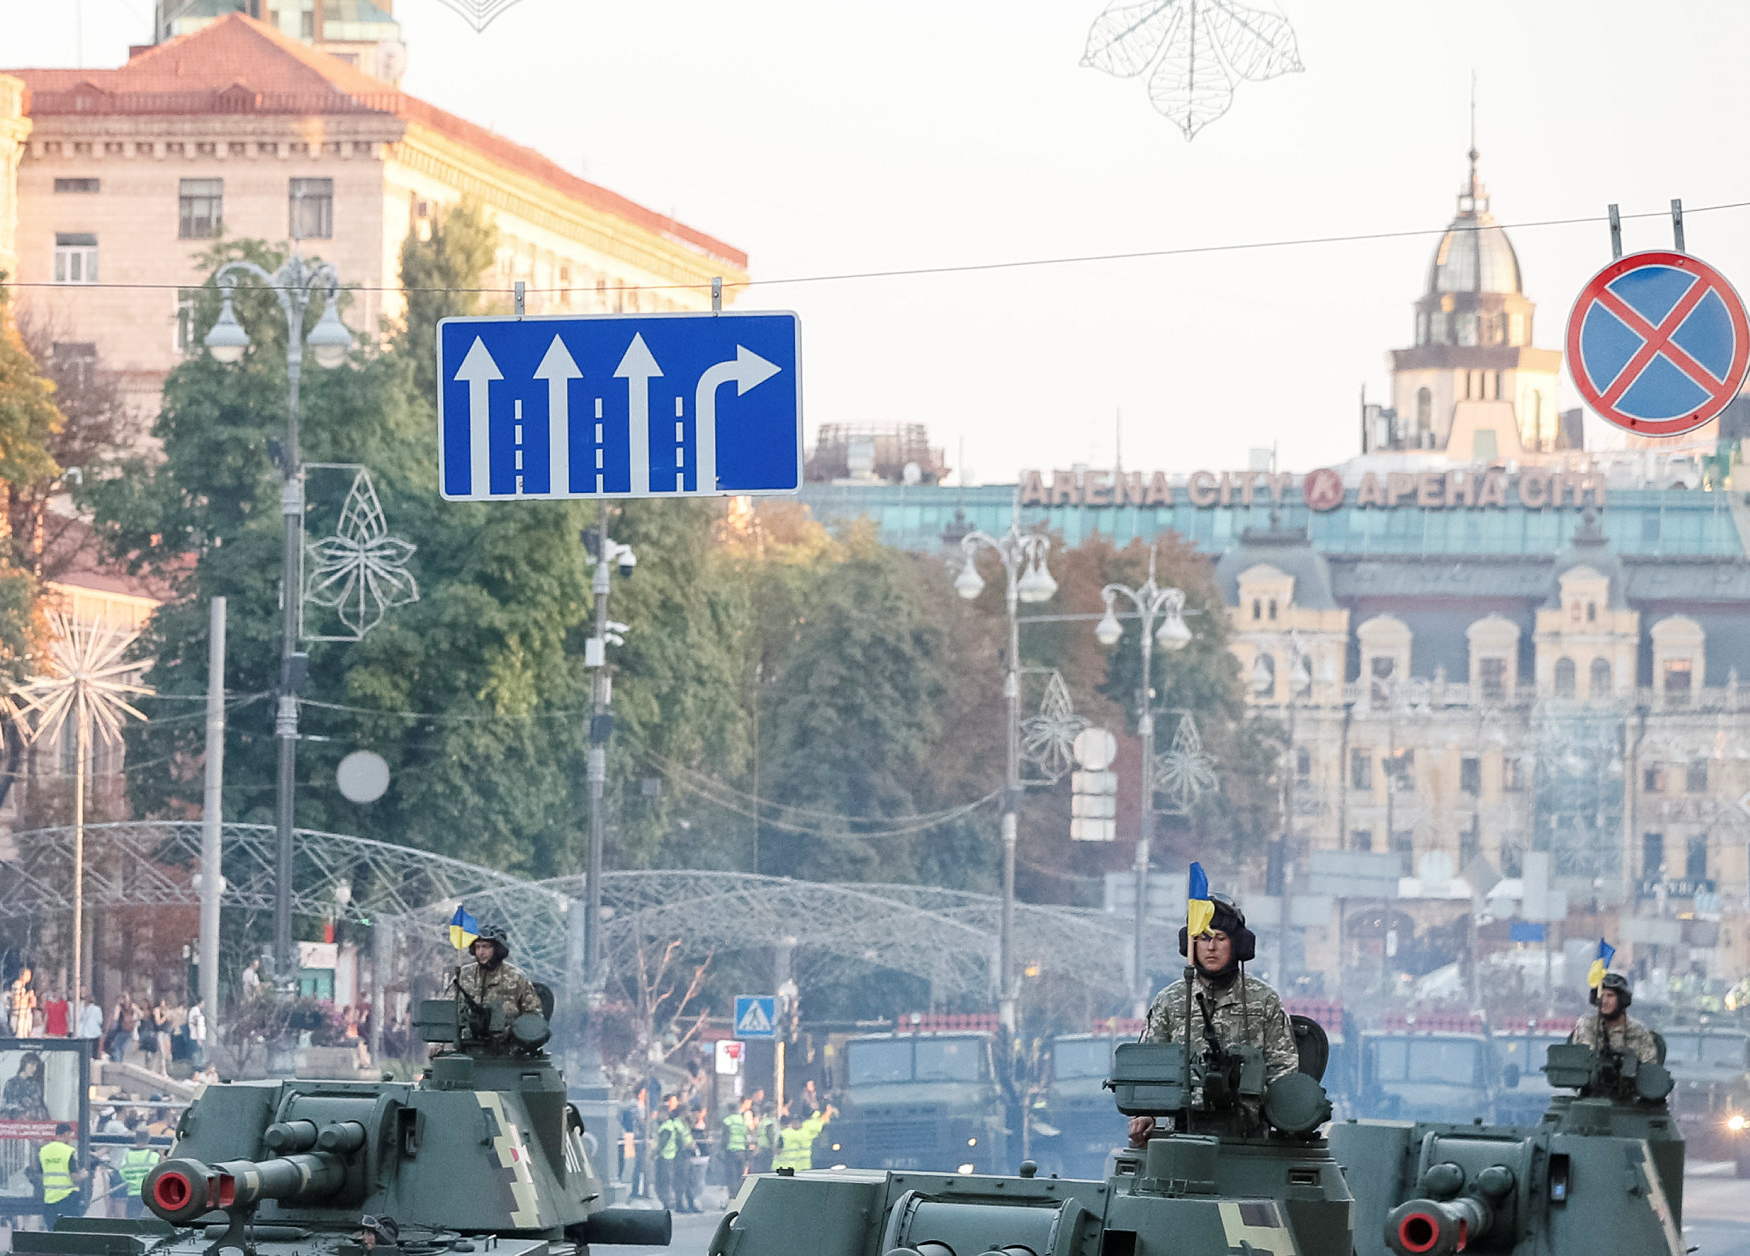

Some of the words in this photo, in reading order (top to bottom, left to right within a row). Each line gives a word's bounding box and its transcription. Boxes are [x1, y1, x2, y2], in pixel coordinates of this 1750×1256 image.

[1022, 471, 1173, 504] ARENA
[1188, 472, 1292, 505] CITY
[1357, 471, 1506, 506] АРЕНА
